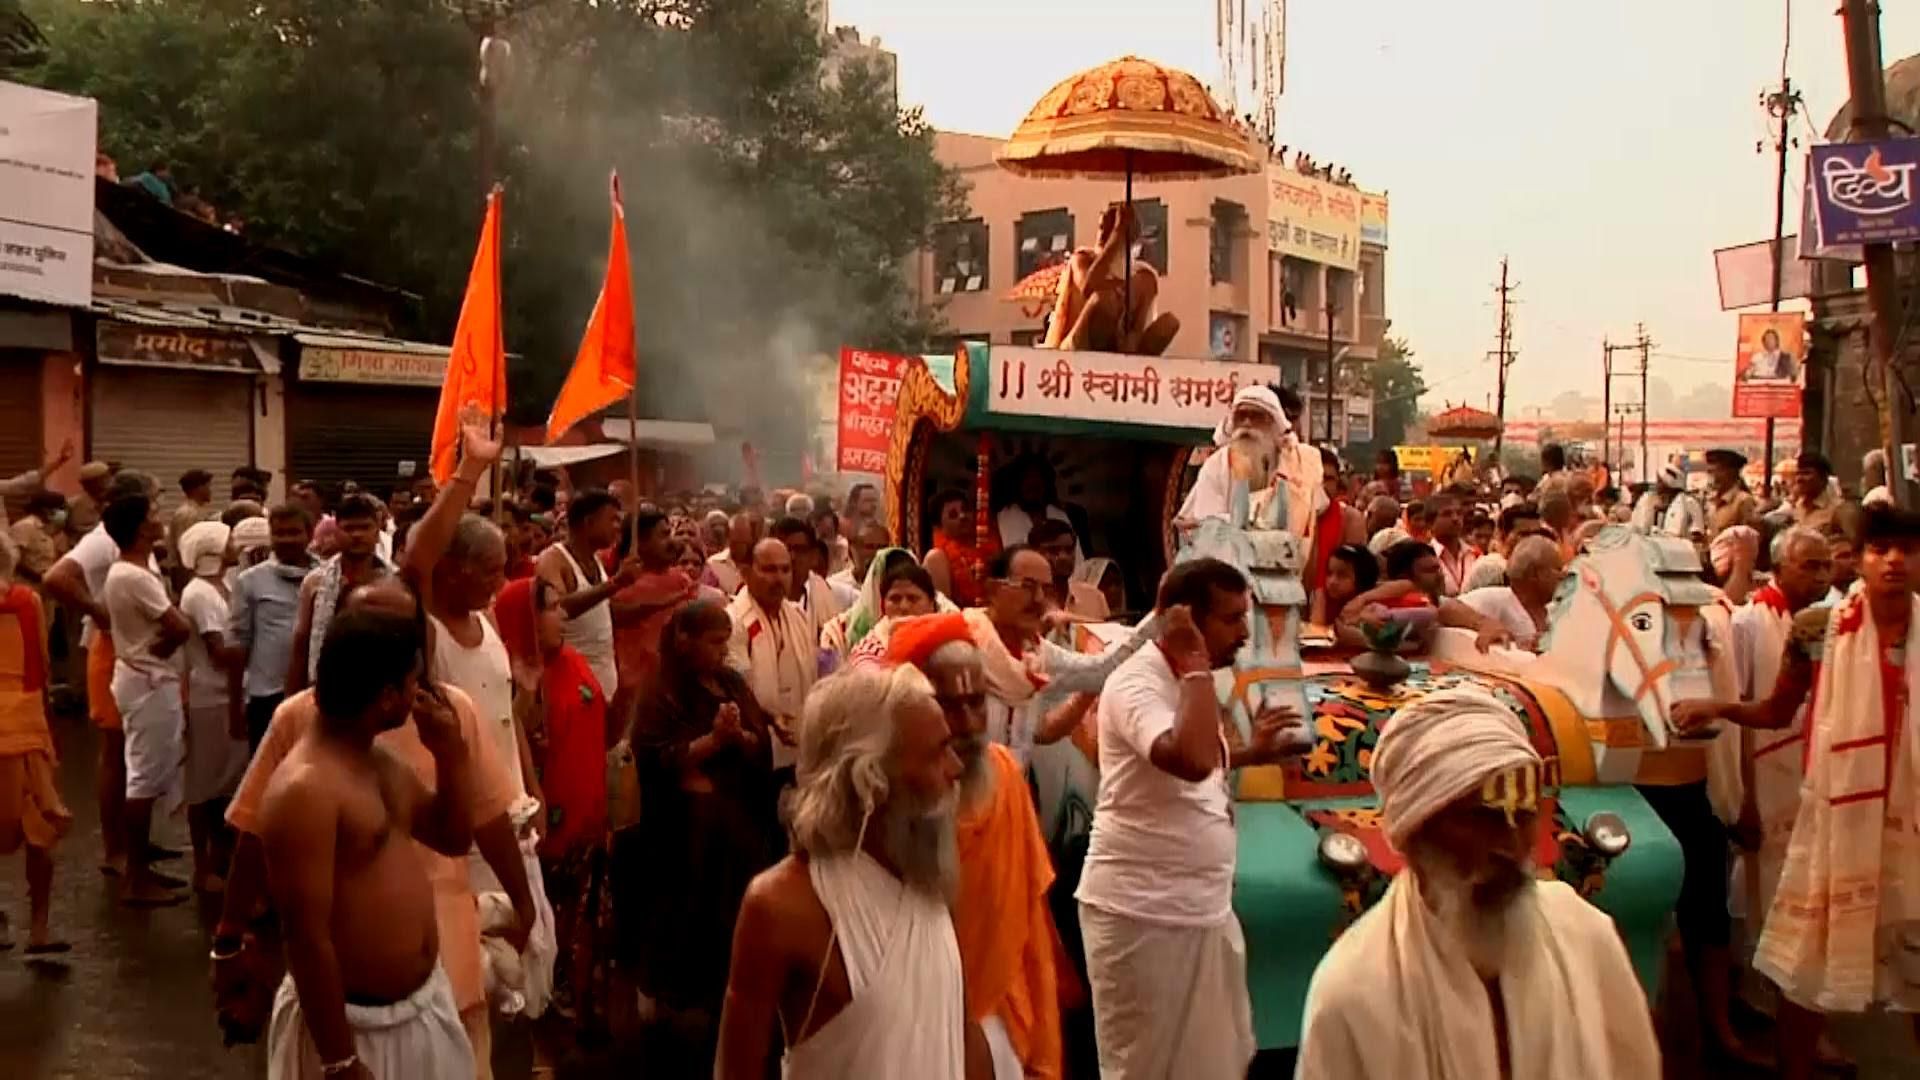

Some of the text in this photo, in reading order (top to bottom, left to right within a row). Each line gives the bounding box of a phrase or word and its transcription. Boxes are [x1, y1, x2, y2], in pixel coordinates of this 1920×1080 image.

[133, 332, 205, 358] प्रमोद
[1037, 358, 1073, 399] श्री
[1081, 364, 1161, 405] स्वामी
[1169, 371, 1239, 410] समर्थ
